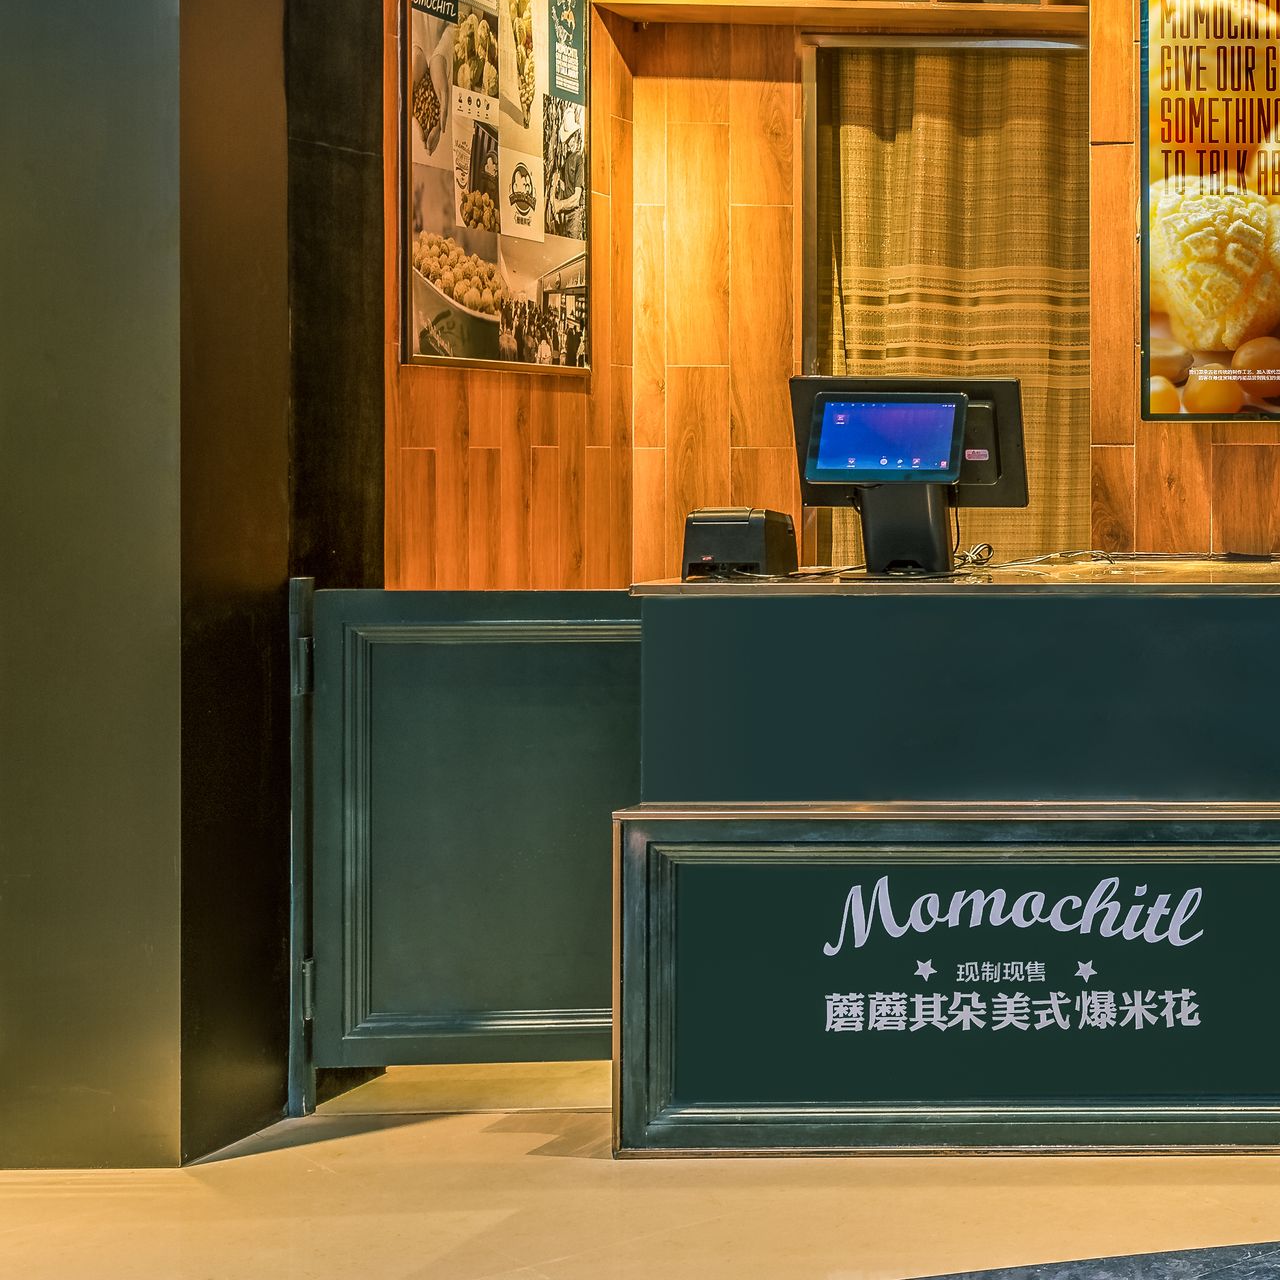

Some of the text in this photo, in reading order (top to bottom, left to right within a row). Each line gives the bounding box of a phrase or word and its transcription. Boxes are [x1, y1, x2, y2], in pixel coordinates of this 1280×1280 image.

[1160, 46, 1207, 92] GIVE
[1216, 46, 1256, 92] OUR
[1160, 150, 1186, 196] TO
[1196, 150, 1248, 196] TALK
[822, 875, 1204, 957] Momochitl
[955, 959, 1047, 984] 现制现售
[824, 988, 1202, 1033] 蘑蘑其朵美式爆米花
